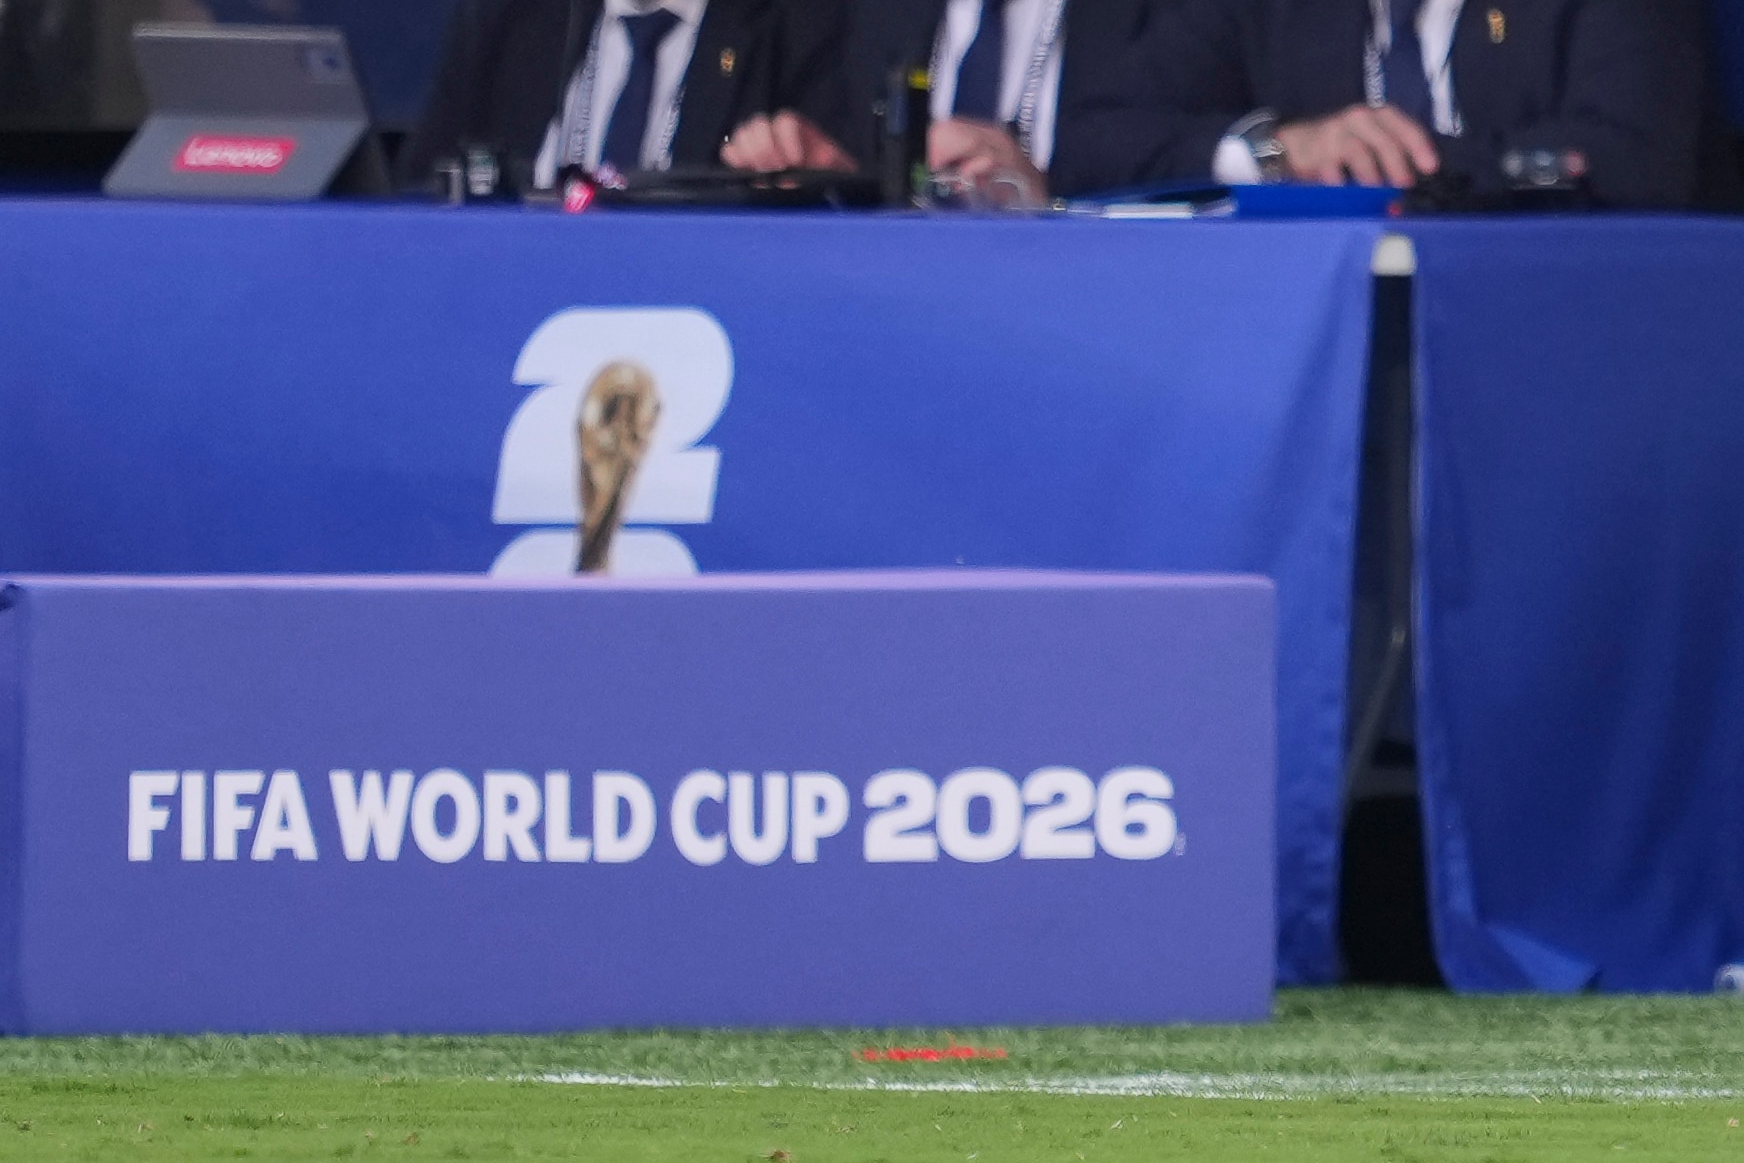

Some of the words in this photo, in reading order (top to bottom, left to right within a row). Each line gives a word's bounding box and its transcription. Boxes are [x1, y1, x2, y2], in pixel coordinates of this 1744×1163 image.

[127, 769, 318, 862] FIFA
[329, 767, 657, 864] WORLD
[671, 768, 851, 866] CUP
[863, 766, 1178, 864] 2026
